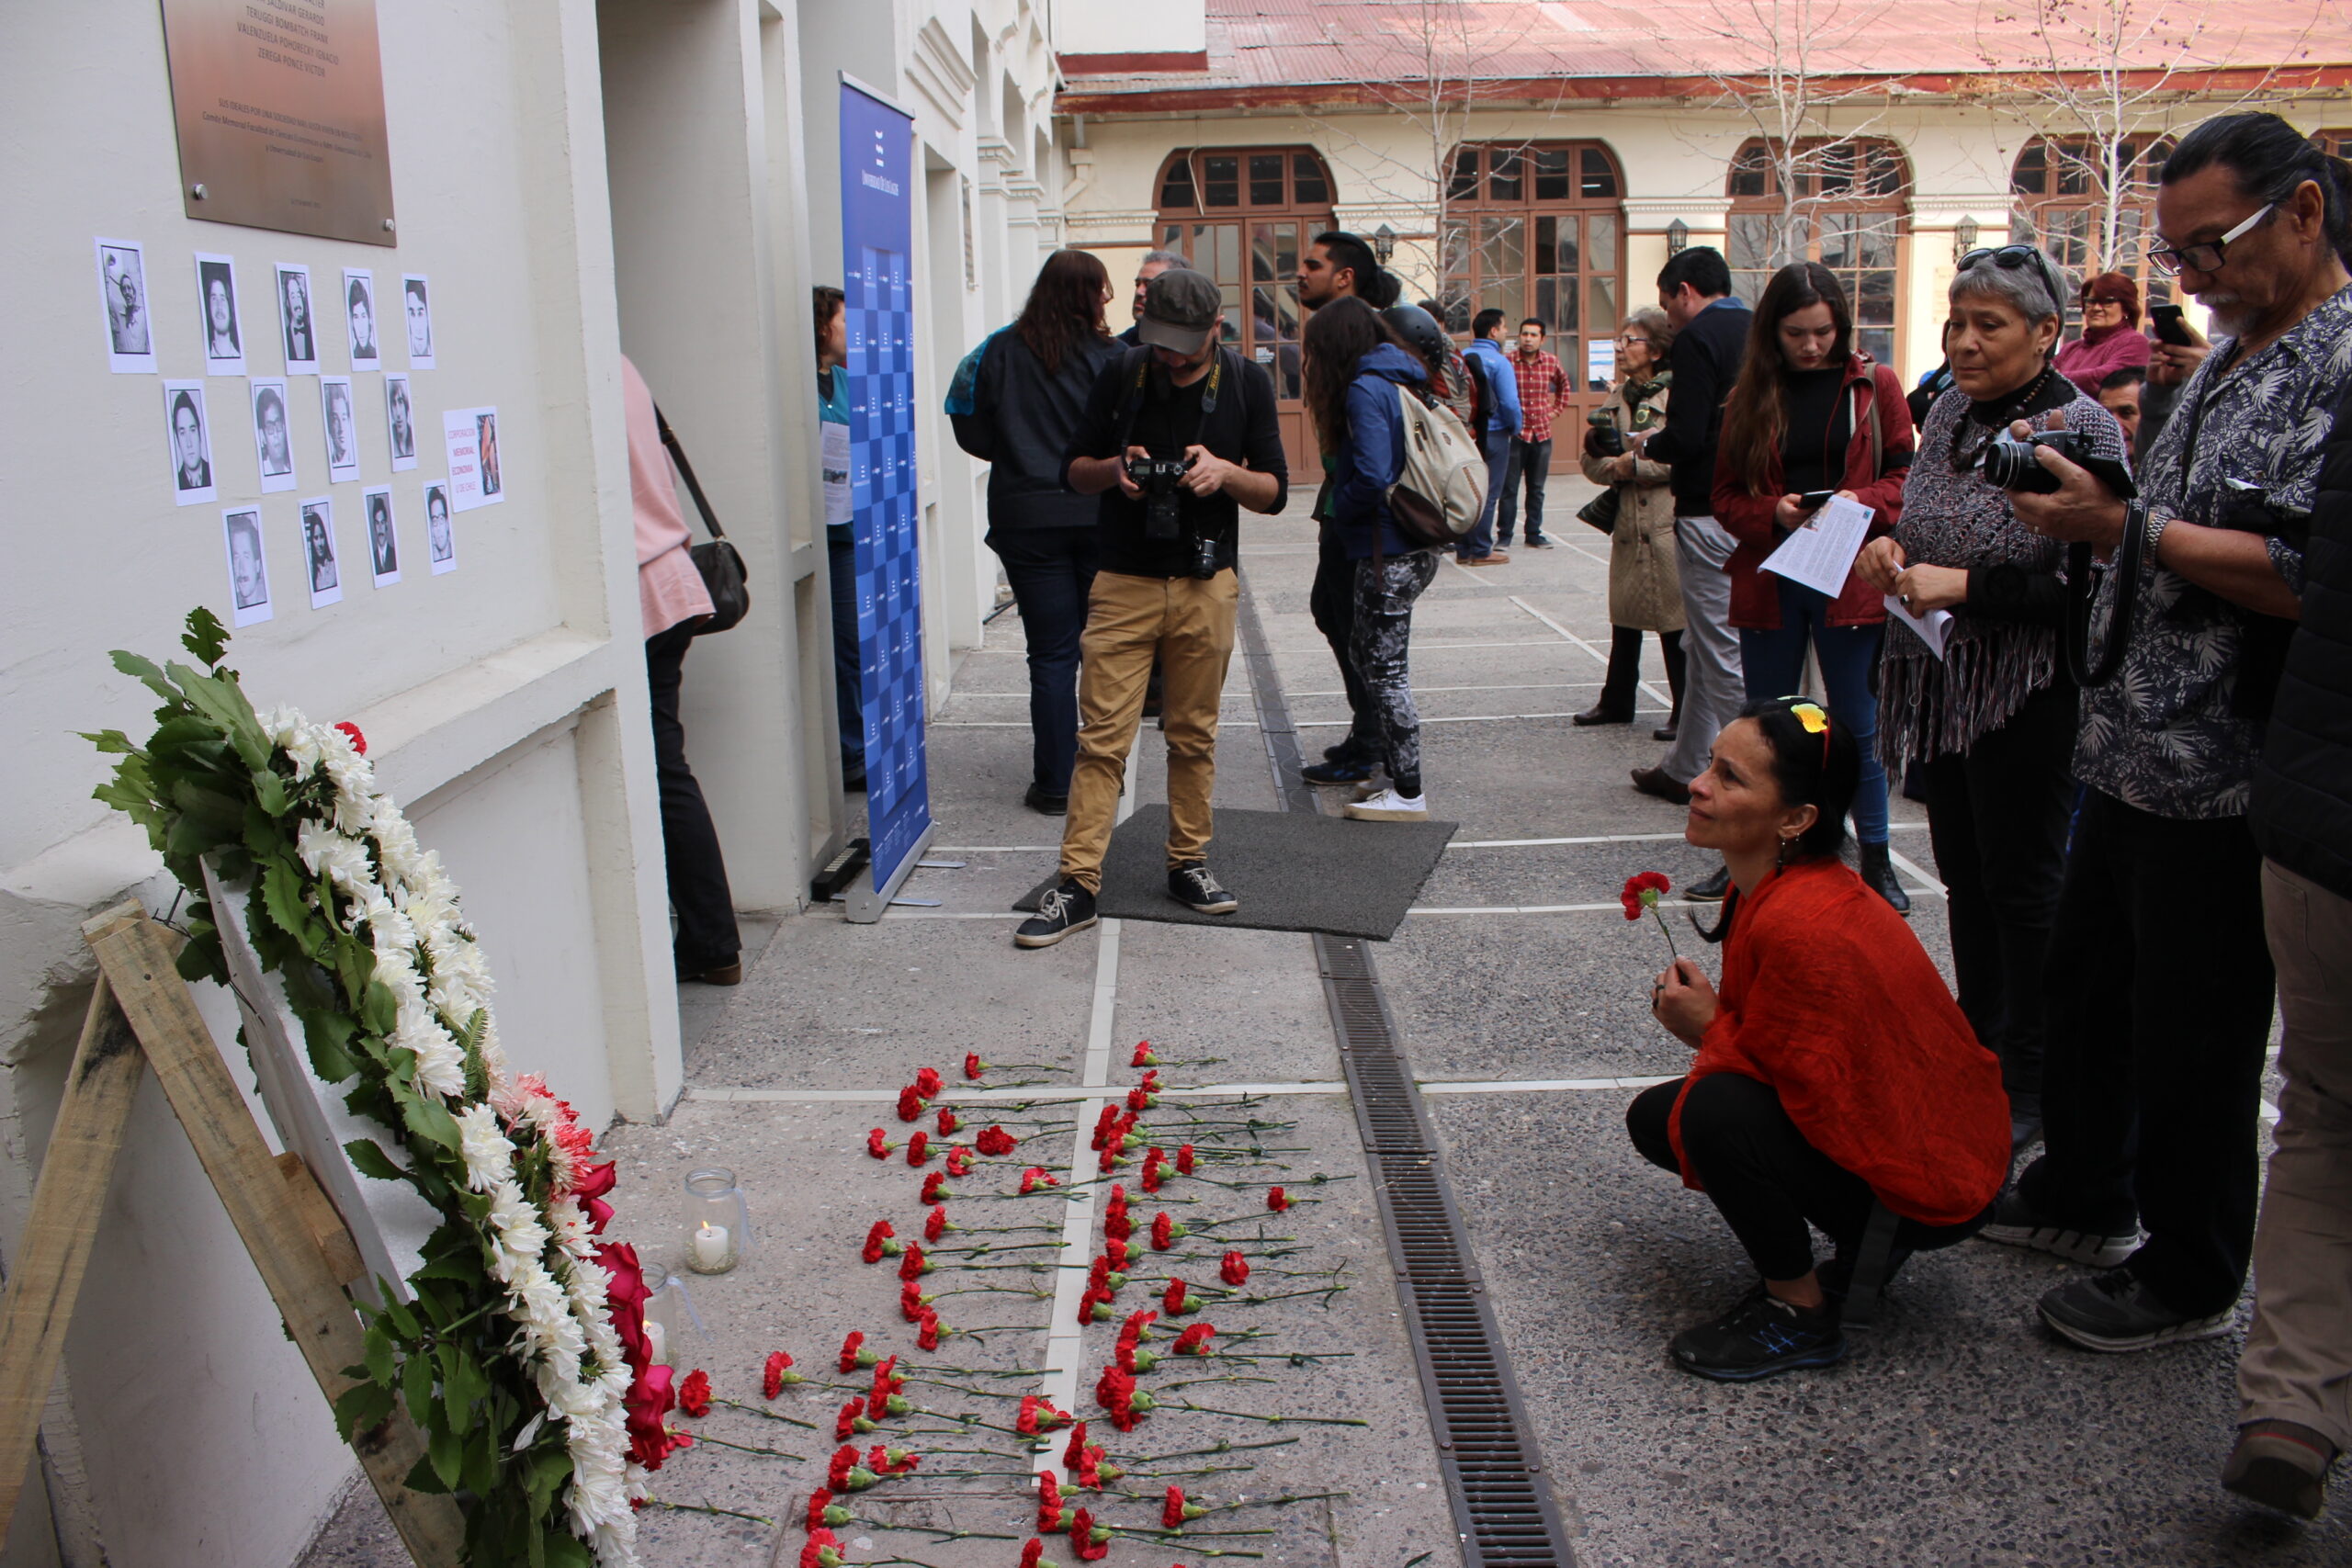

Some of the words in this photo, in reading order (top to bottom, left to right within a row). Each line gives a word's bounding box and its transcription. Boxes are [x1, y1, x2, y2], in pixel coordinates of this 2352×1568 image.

[245, 6, 275, 25] TERUGGI
[275, 16, 310, 38] BOMBATCH
[310, 28, 329, 44] FRANK
[297, 7, 325, 27] GERARDO
[236, 21, 277, 44] VALENZUELA
[315, 49, 339, 65] IGNACIO
[257, 47, 281, 63] ZEREGA
[282, 55, 304, 72] PONCE
[304, 62, 325, 77] VICTOR
[453, 446, 475, 457] MEMORIAL
